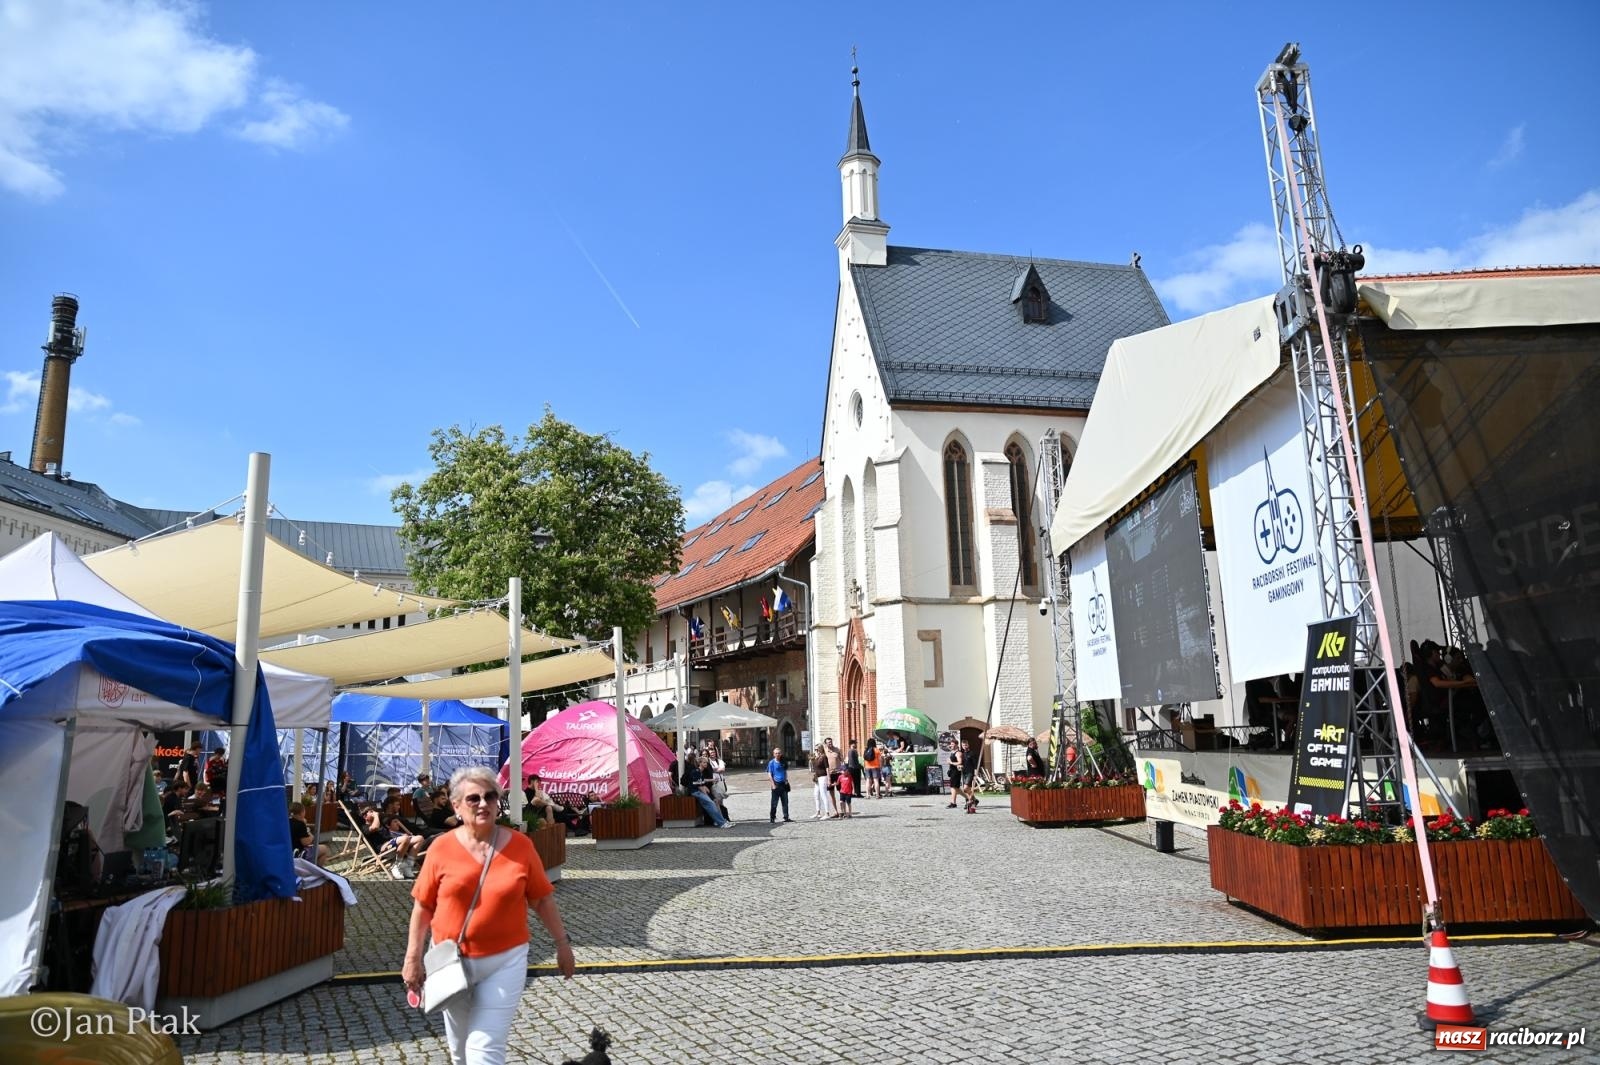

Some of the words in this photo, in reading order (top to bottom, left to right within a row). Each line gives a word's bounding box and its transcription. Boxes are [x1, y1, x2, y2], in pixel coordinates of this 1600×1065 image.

[1252, 565, 1285, 590] RACIBORSKI
[1286, 553, 1317, 577] FESTIWAL
[1268, 577, 1304, 603] GAMINGOWY
[1310, 677, 1350, 692] GAMING
[566, 722, 604, 731] TAURON
[1313, 723, 1345, 743] PART
[1307, 743, 1323, 753] OF
[1324, 744, 1348, 755] THE
[1310, 757, 1343, 768] GAME
[540, 781, 609, 795] TAURONA
